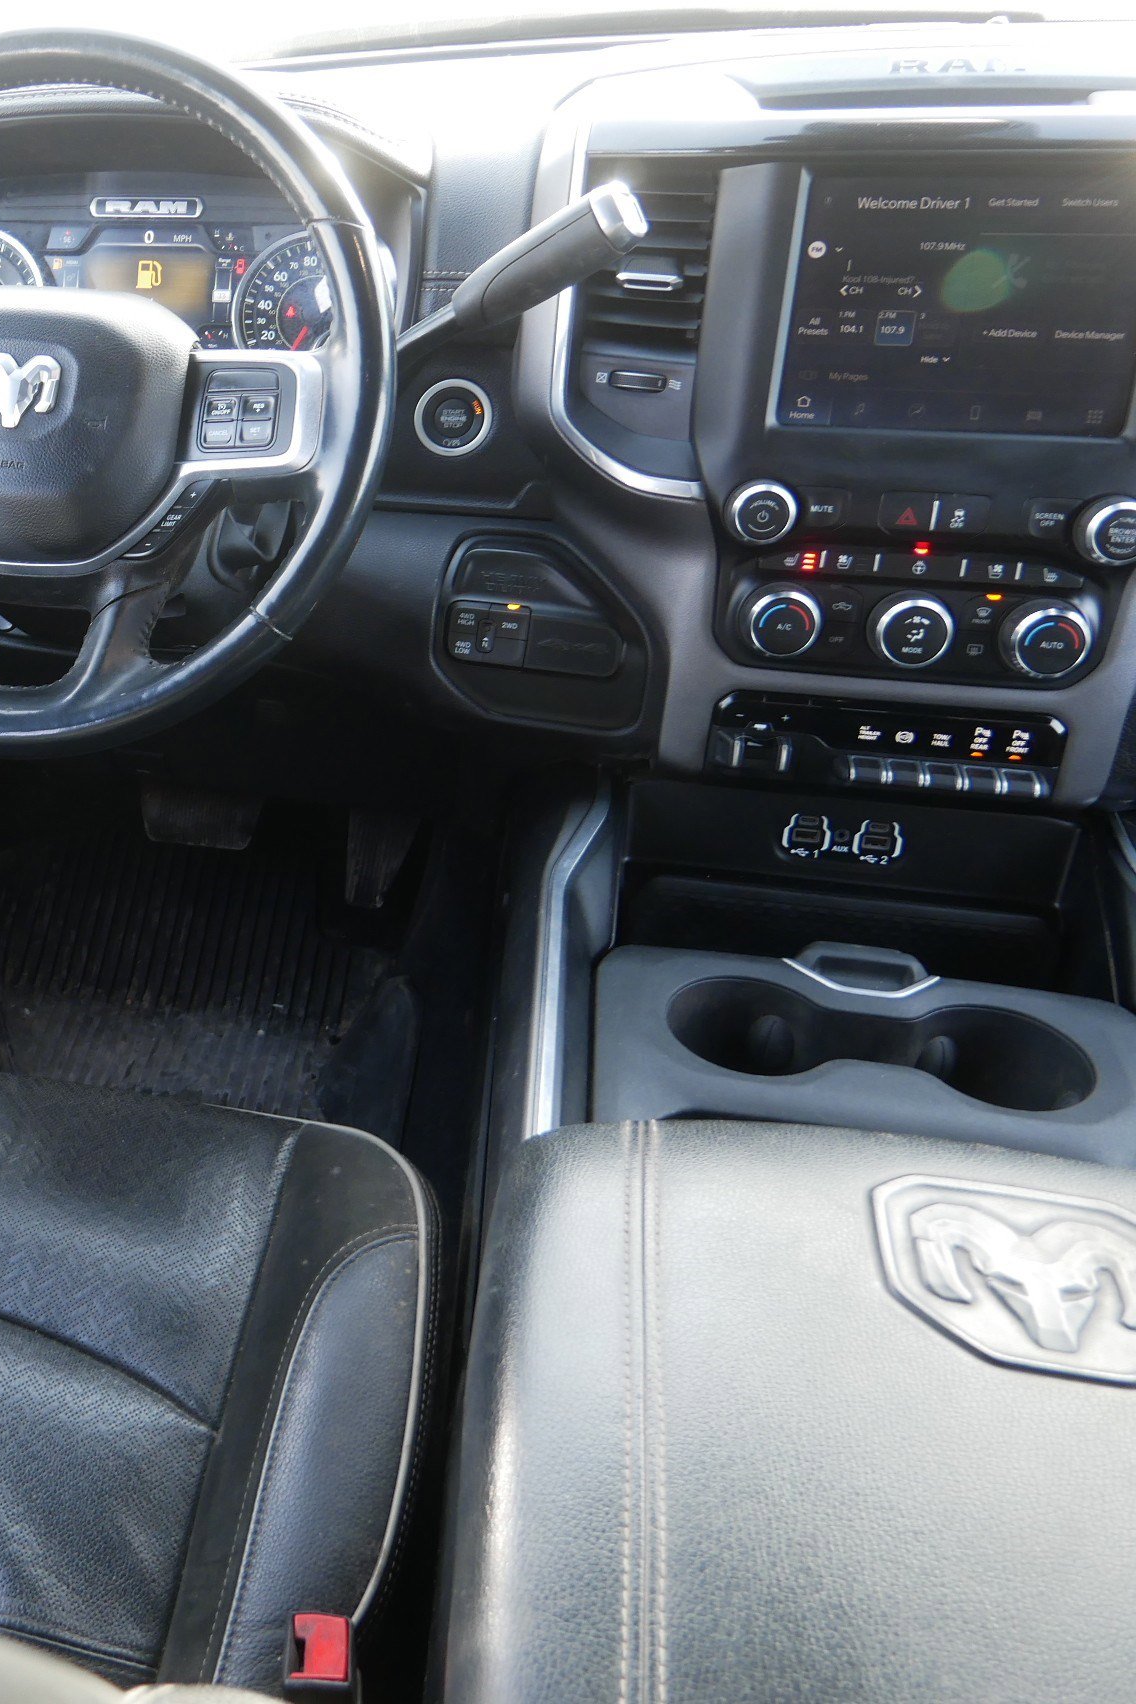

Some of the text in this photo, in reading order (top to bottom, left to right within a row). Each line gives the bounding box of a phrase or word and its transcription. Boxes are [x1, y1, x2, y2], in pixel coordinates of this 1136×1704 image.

[105, 200, 188, 214] RAM
[857, 197, 971, 210] Welcome Driver 1
[1006, 198, 1040, 207] Started
[144, 230, 192, 244] 0 MPH
[304, 256, 318, 266] 80
[289, 262, 299, 270] 70
[273, 271, 288, 282] 60
[848, 286, 863, 295] CH
[897, 287, 912, 296] CH
[258, 300, 273, 310] 40
[256, 317, 266, 325] 30
[808, 317, 821, 326] All
[798, 327, 829, 336] Presets
[839, 325, 864, 334] 104.1
[880, 325, 906, 335] 107.9
[988, 329, 1038, 338] Add Device
[261, 331, 275, 341] 20
[1054, 330, 1126, 341] Device Manager
[789, 410, 815, 420] Home
[809, 504, 835, 514] MUTE
[1034, 512, 1064, 520] SCREEN
[1039, 520, 1055, 528] OFF
[1108, 527, 1136, 536] BROWS
[458, 612, 475, 620] 4WD
[457, 618, 475, 626] HIGH
[501, 621, 518, 630] 2WD
[776, 622, 792, 631] A/C
[454, 640, 471, 648] 4WD
[1039, 640, 1064, 650] AUTO
[454, 647, 471, 655] LOW
[901, 646, 923, 654] MODE
[932, 733, 952, 741] TOW/
[930, 740, 950, 748] HAUL
[970, 743, 989, 751] REAR
[1005, 746, 1030, 754] FRONT
[831, 844, 849, 853] AUX
[812, 849, 819, 859] 1
[879, 855, 889, 865] 2
